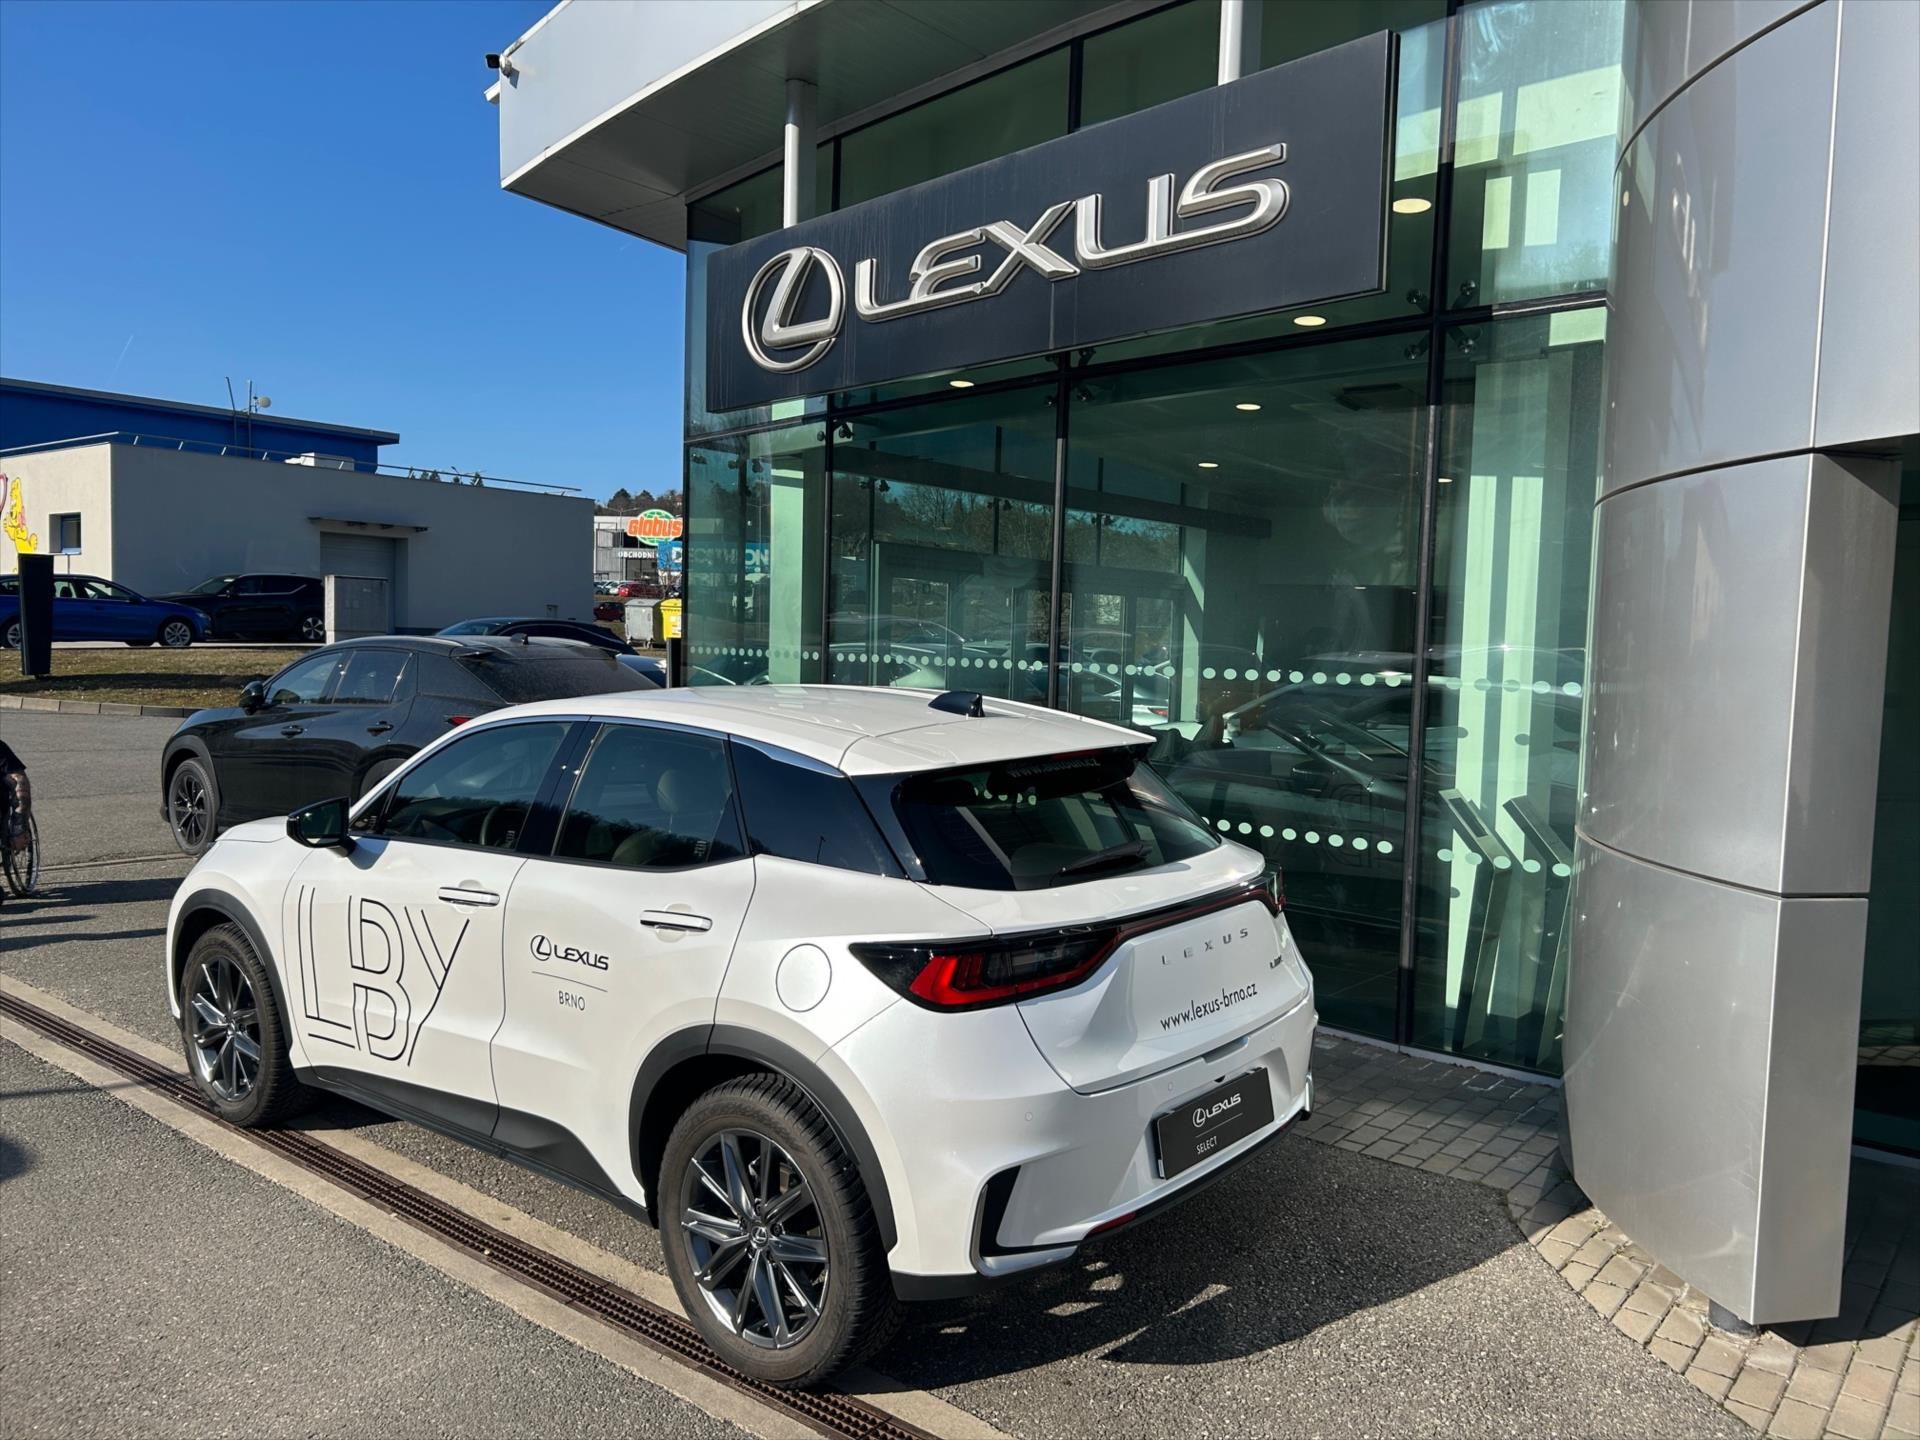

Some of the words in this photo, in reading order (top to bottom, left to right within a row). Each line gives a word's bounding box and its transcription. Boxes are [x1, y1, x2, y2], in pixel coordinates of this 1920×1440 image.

[855, 142, 1290, 323] LEXUS
[553, 944, 610, 971] LEXUS
[1161, 927, 1249, 966] LEXUS
[298, 885, 470, 1067] LBY
[558, 990, 586, 1012] BRNO
[1160, 981, 1258, 1031] www.lexus-brno.cz
[1205, 1092, 1242, 1118] LEXUS
[1196, 1135, 1218, 1155] SELECT
